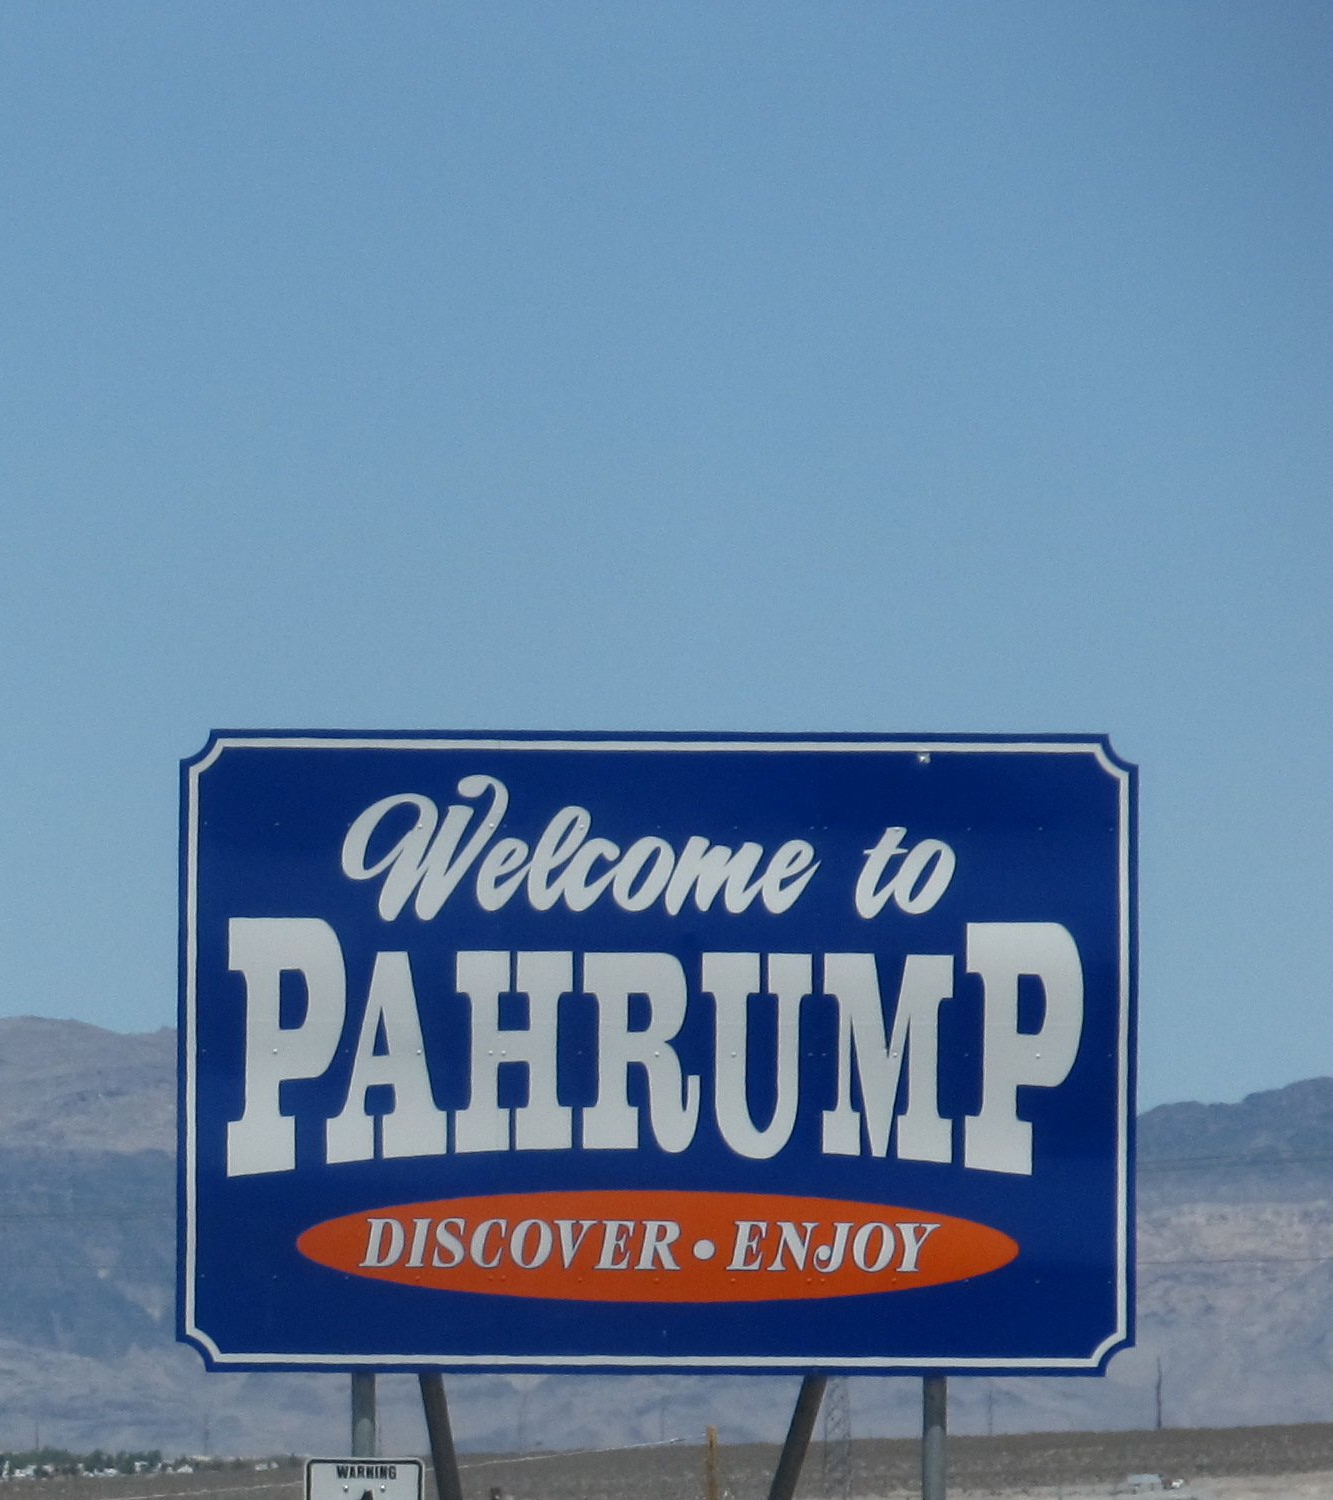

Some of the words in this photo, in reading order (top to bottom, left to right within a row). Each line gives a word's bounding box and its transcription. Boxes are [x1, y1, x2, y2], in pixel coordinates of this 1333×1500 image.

[341, 774, 819, 922] Welcome
[853, 826, 957, 919] to
[226, 917, 1085, 1177] PAHRUMP
[358, 1217, 681, 1272] DISCOVER
[725, 1223, 939, 1275] ENJOY
[337, 1465, 397, 1480] WARNING
